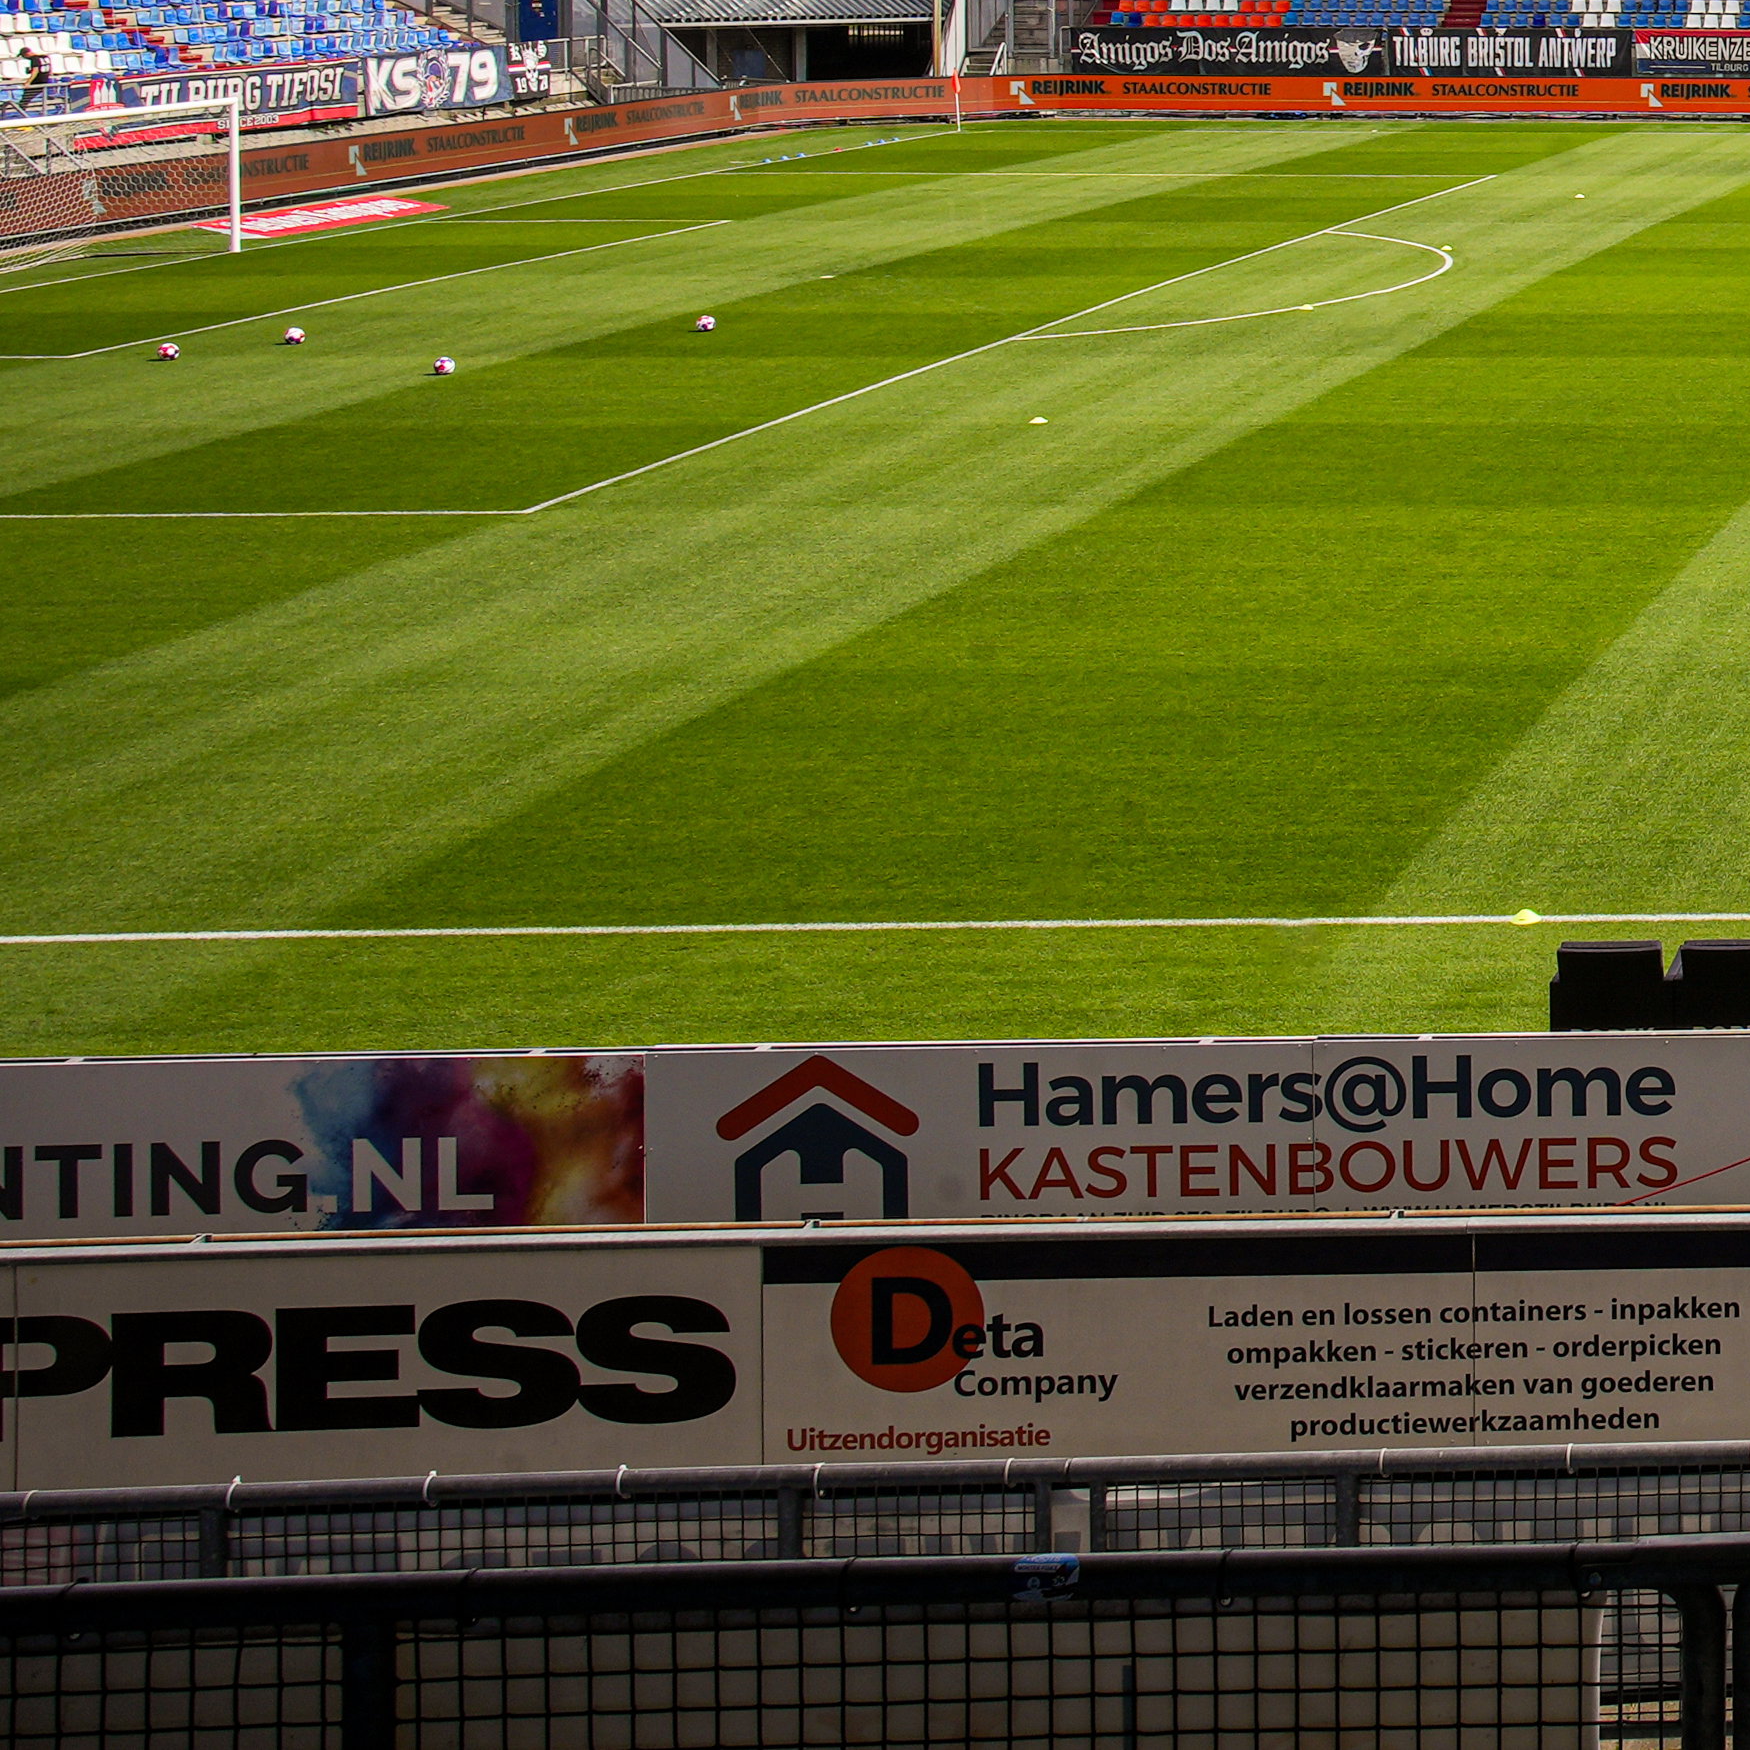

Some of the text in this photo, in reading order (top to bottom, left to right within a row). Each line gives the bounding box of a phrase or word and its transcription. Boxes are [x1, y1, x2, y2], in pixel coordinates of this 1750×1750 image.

[1077, 30, 1331, 72] Amigos Dos Amigos
[1392, 34, 1617, 69] TILBURG BRISTOL ANTWERP
[1710, 63, 1750, 73] TILBURG
[365, 51, 499, 113] KS 79
[1343, 81, 1579, 98] REIJRINK STAALCONSTRUCTIE
[975, 1054, 1678, 1134] Hamers@Home
[977, 1133, 1679, 1204] KASTENBOUWERS
[868, 1275, 1045, 1367] Deta
[1207, 1304, 1294, 1329] Laden
[1301, 1309, 1336, 1327] en
[1343, 1302, 1432, 1327] lossen
[1438, 1297, 1587, 1325] containers
[1610, 1295, 1742, 1328] inpakken
[1225, 1339, 1377, 1367] ompakken
[1401, 1336, 1528, 1362] stickeren
[1551, 1333, 1722, 1365] orderpicken
[953, 1369, 1119, 1402] Company
[1233, 1370, 1715, 1403] verzendklaarmaken van goederen
[786, 1423, 1051, 1456] Uitzendorganisatie
[1289, 1407, 1661, 1443] productiewerkzaamheden
